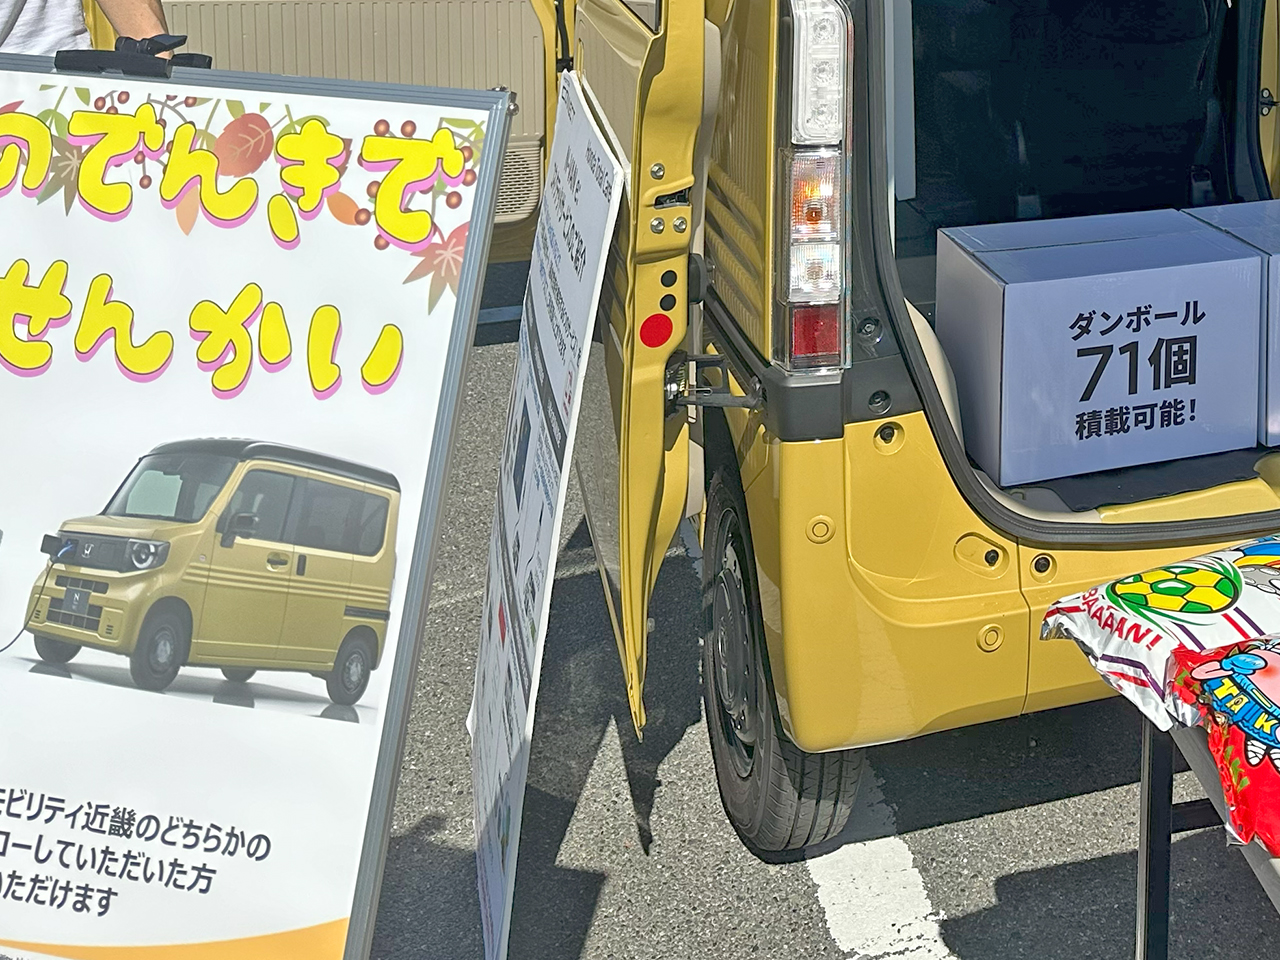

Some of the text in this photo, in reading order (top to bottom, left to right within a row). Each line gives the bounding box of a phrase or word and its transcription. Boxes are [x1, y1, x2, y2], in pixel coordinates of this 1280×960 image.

[1068, 300, 1207, 342] ダンボール
[1078, 335, 1198, 403] 71個
[1074, 400, 1197, 441] 積載可能!
